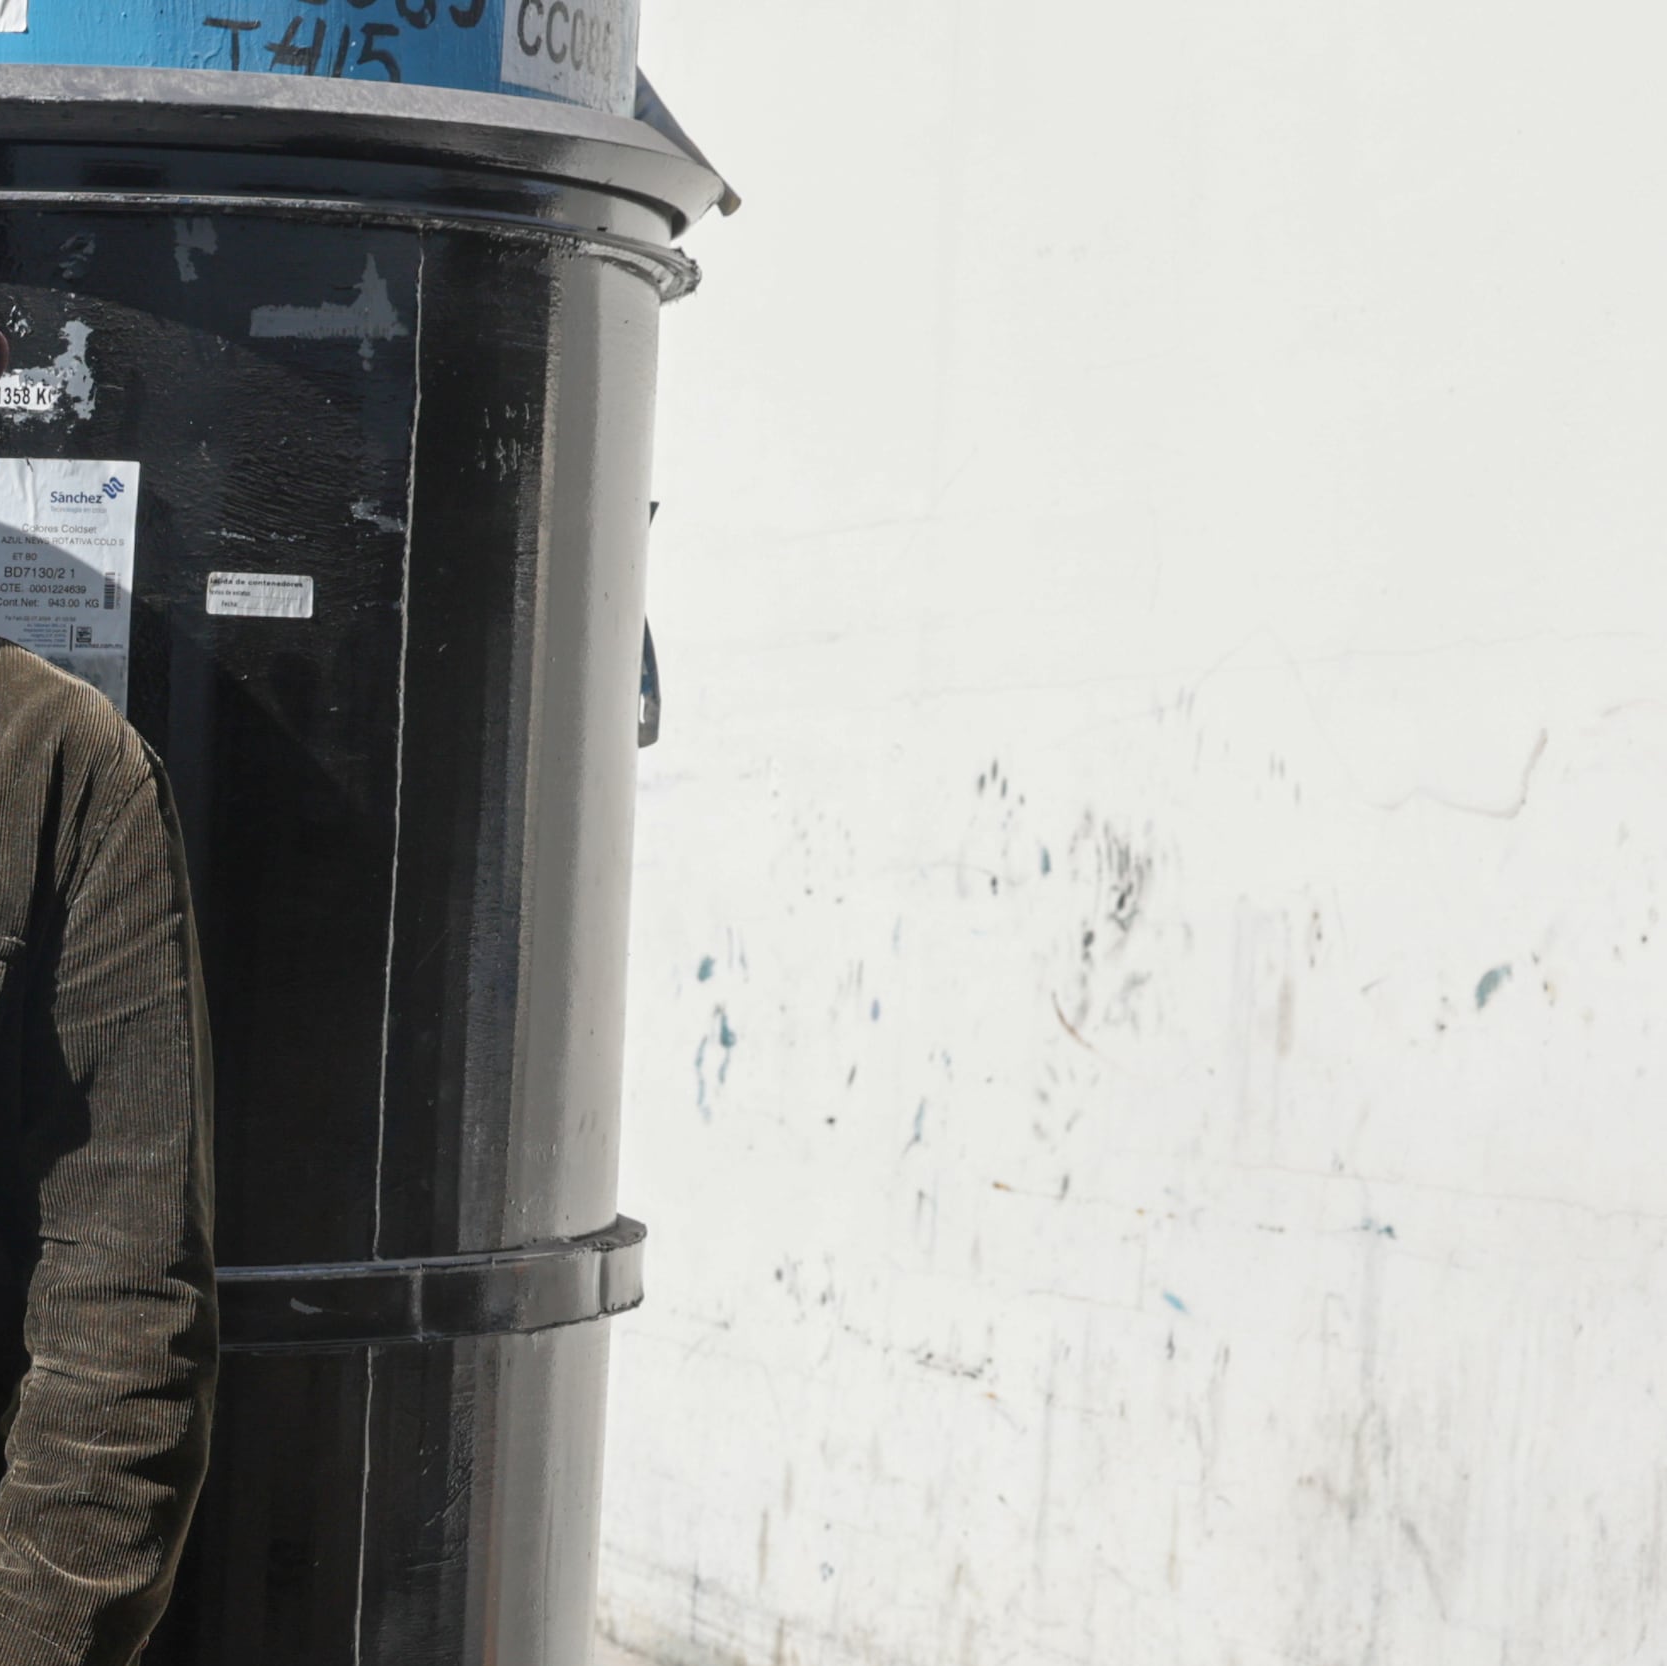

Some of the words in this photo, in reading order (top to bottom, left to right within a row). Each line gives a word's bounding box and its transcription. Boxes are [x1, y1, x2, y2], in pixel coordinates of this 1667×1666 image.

[50, 491, 103, 504] Sánchez
[61, 524, 97, 534] Coldset
[4, 567, 66, 579] BD7130/2
[84, 599, 99, 609] KG
